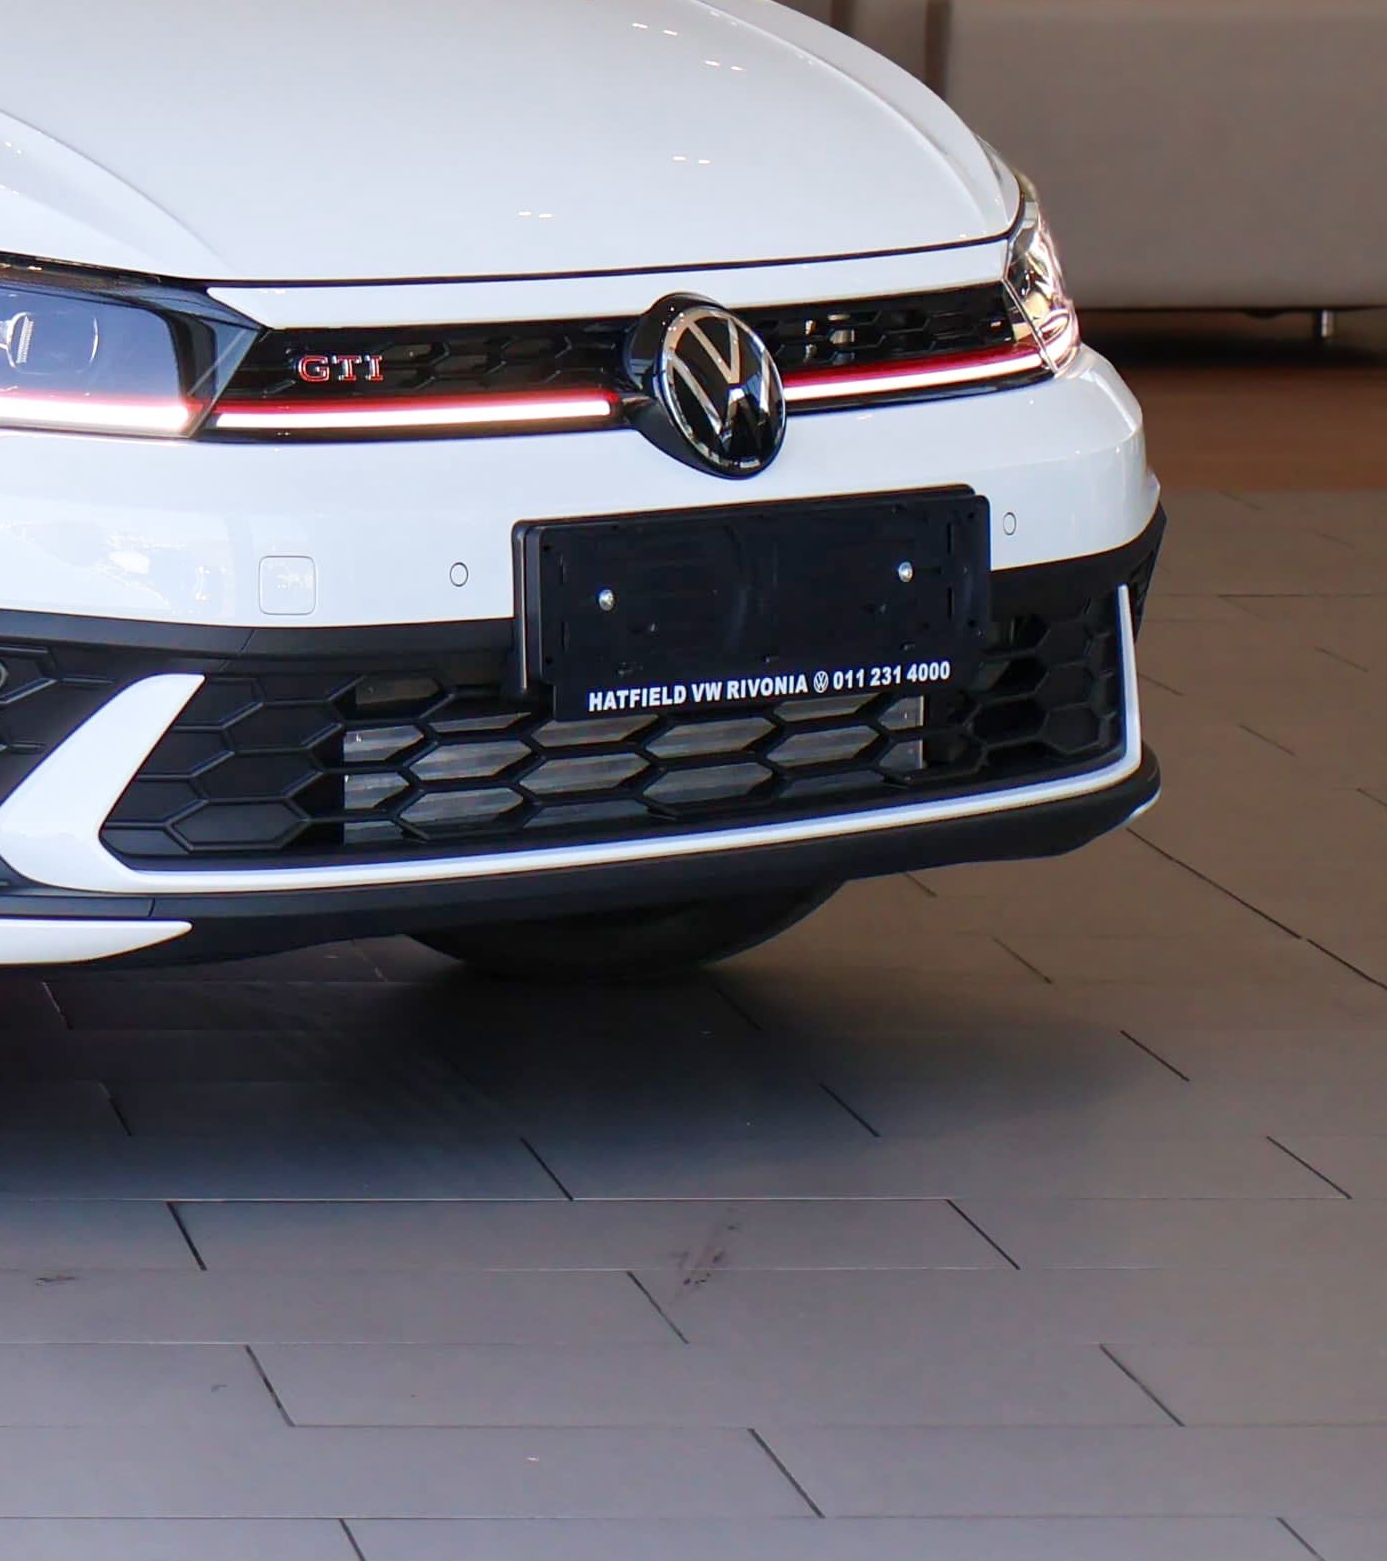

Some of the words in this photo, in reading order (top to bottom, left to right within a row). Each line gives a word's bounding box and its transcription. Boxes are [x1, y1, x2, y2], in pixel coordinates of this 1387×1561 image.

[298, 355, 385, 382] GTI
[588, 685, 687, 712] HATFIELD
[691, 682, 723, 703] VW
[727, 674, 809, 700] RIVONIA
[833, 668, 865, 690] 011
[870, 665, 902, 687] 231
[907, 660, 951, 683] 4000
